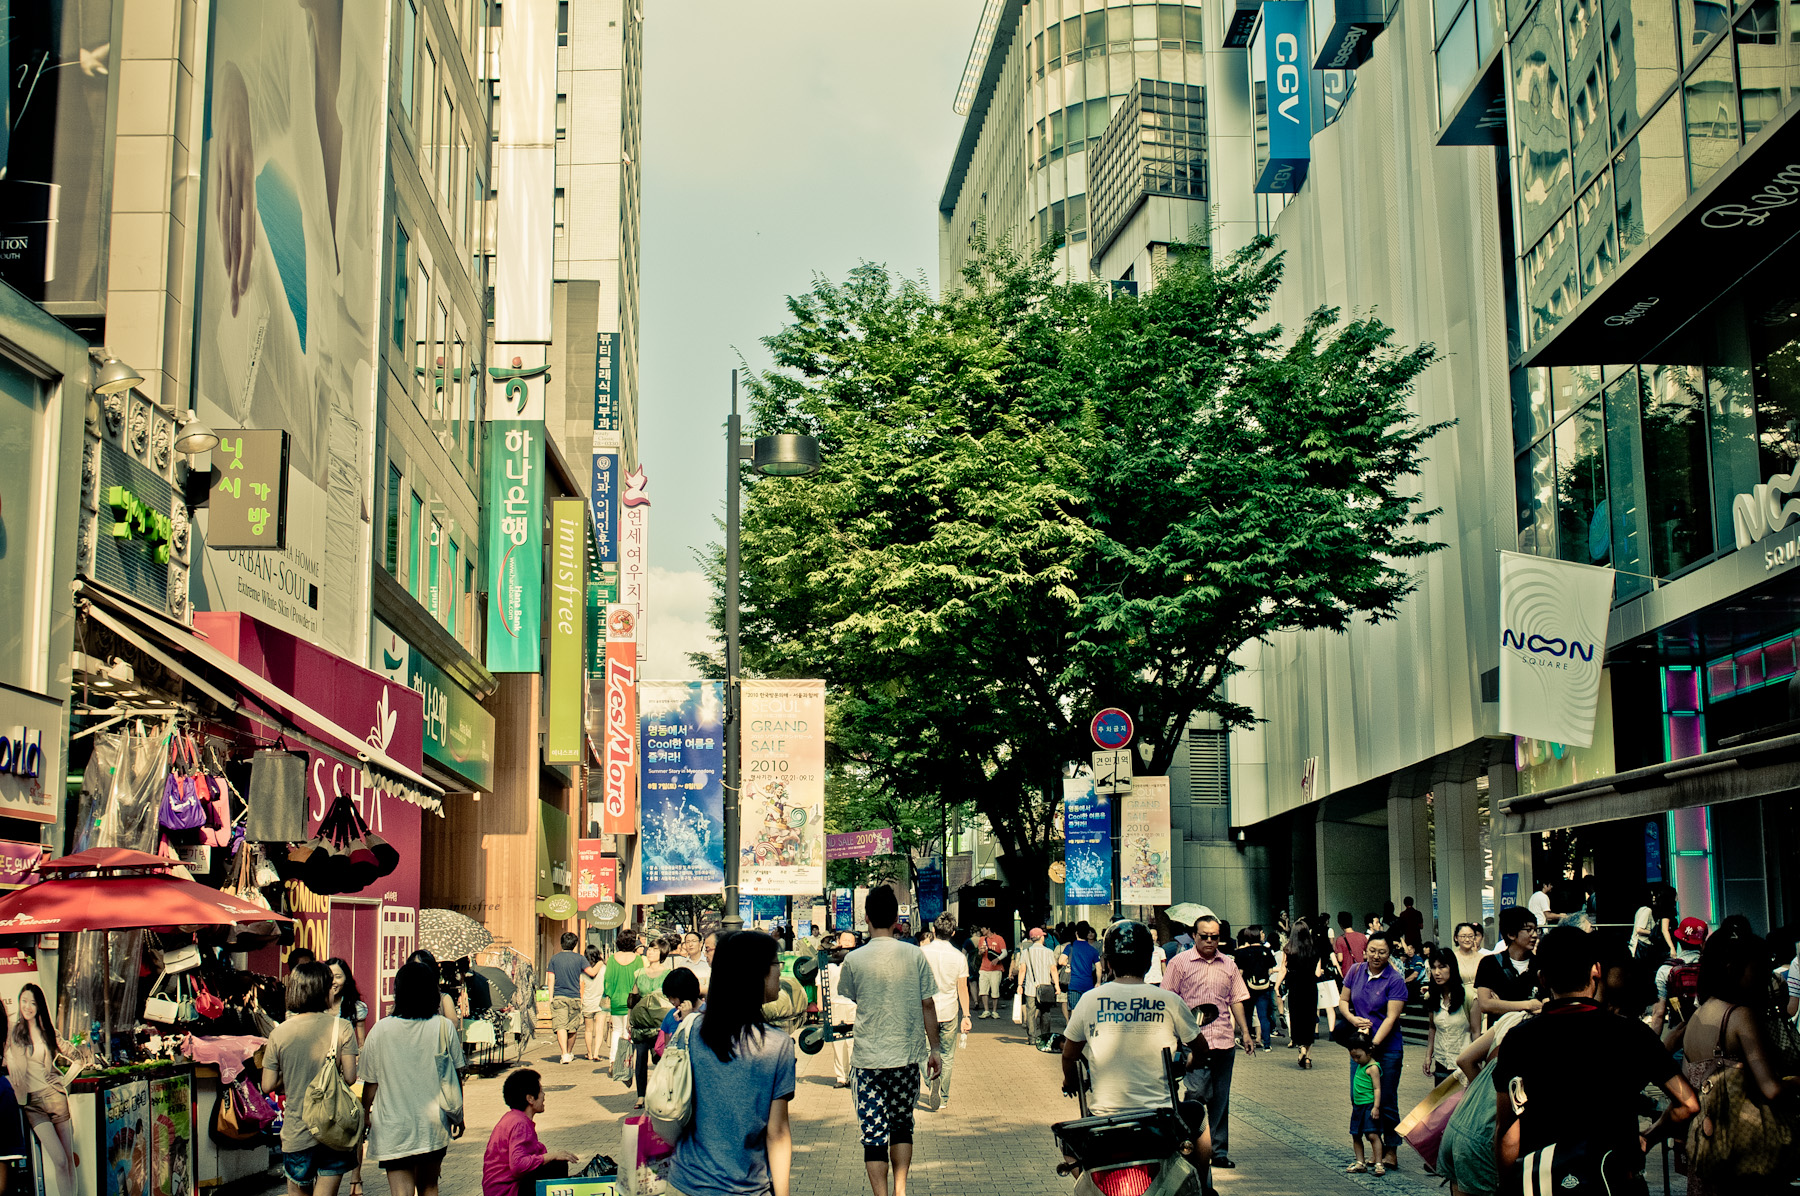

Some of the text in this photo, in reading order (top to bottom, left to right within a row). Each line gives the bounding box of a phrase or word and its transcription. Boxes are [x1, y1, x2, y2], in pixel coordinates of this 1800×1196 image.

[1275, 33, 1300, 125] CGV
[1270, 164, 1295, 190] CGV
[598, 394, 611, 430] 피부과
[218, 437, 244, 499] 닛시
[501, 429, 533, 546] 하나은행
[248, 482, 271, 536] 가방
[1765, 536, 1800, 571] SQU
[295, 548, 319, 578] HOMME
[228, 550, 307, 605] URBAN-SOUL
[554, 518, 581, 635] innisfree
[237, 576, 318, 633] Extreme White Skin (Powder in)
[514, 585, 522, 631] Hana Bank
[1502, 629, 1594, 662] NOON
[1521, 655, 1569, 671] SQUARE
[752, 700, 801, 713] SEOUL
[648, 725, 688, 737] 명동에서
[750, 720, 808, 733] GRAND
[1098, 725, 1127, 733] 주차금지
[607, 658, 635, 817] LesMore
[648, 738, 715, 750] Cool한 여름을
[751, 740, 785, 752] SALE
[648, 751, 681, 763] 즐겨라!
[1096, 755, 1129, 767] 견인지역
[751, 760, 789, 772] 2010
[1126, 800, 1161, 808] GRAND
[1127, 813, 1148, 821] SALE
[1127, 824, 1150, 832] 2010
[838, 836, 854, 846] SALE
[856, 833, 874, 845] 2010
[449, 900, 500, 913] innisfree
[1501, 896, 1516, 906] CGV
[18, 917, 61, 926] telecom
[1097, 996, 1166, 1011] The Blue
[1097, 1008, 1164, 1023] Empolham
